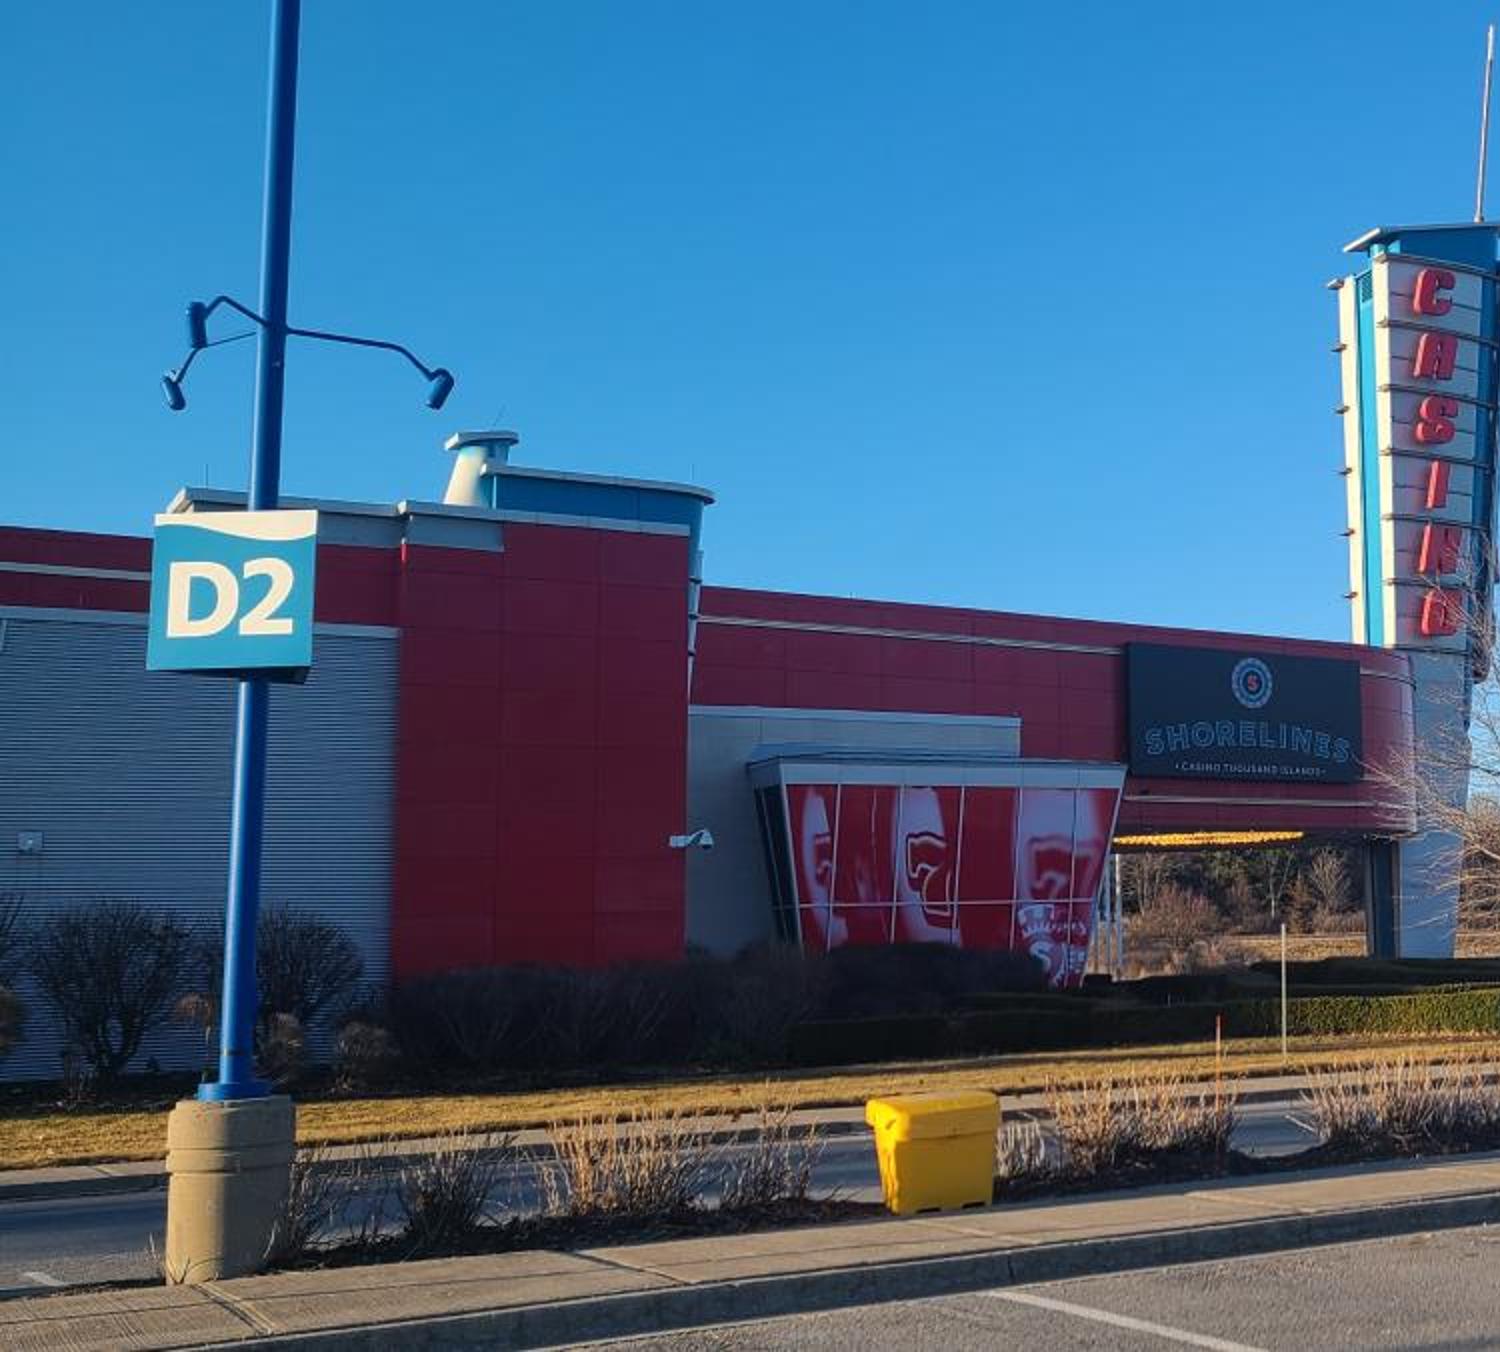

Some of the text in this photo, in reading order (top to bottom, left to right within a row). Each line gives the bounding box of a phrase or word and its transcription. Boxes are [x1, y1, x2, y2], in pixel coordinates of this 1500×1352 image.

[1413, 268, 1461, 636] CASINO
[166, 557, 294, 638] D2
[1145, 721, 1350, 763] SHORELINES
[1181, 761, 1222, 773] CASINO
